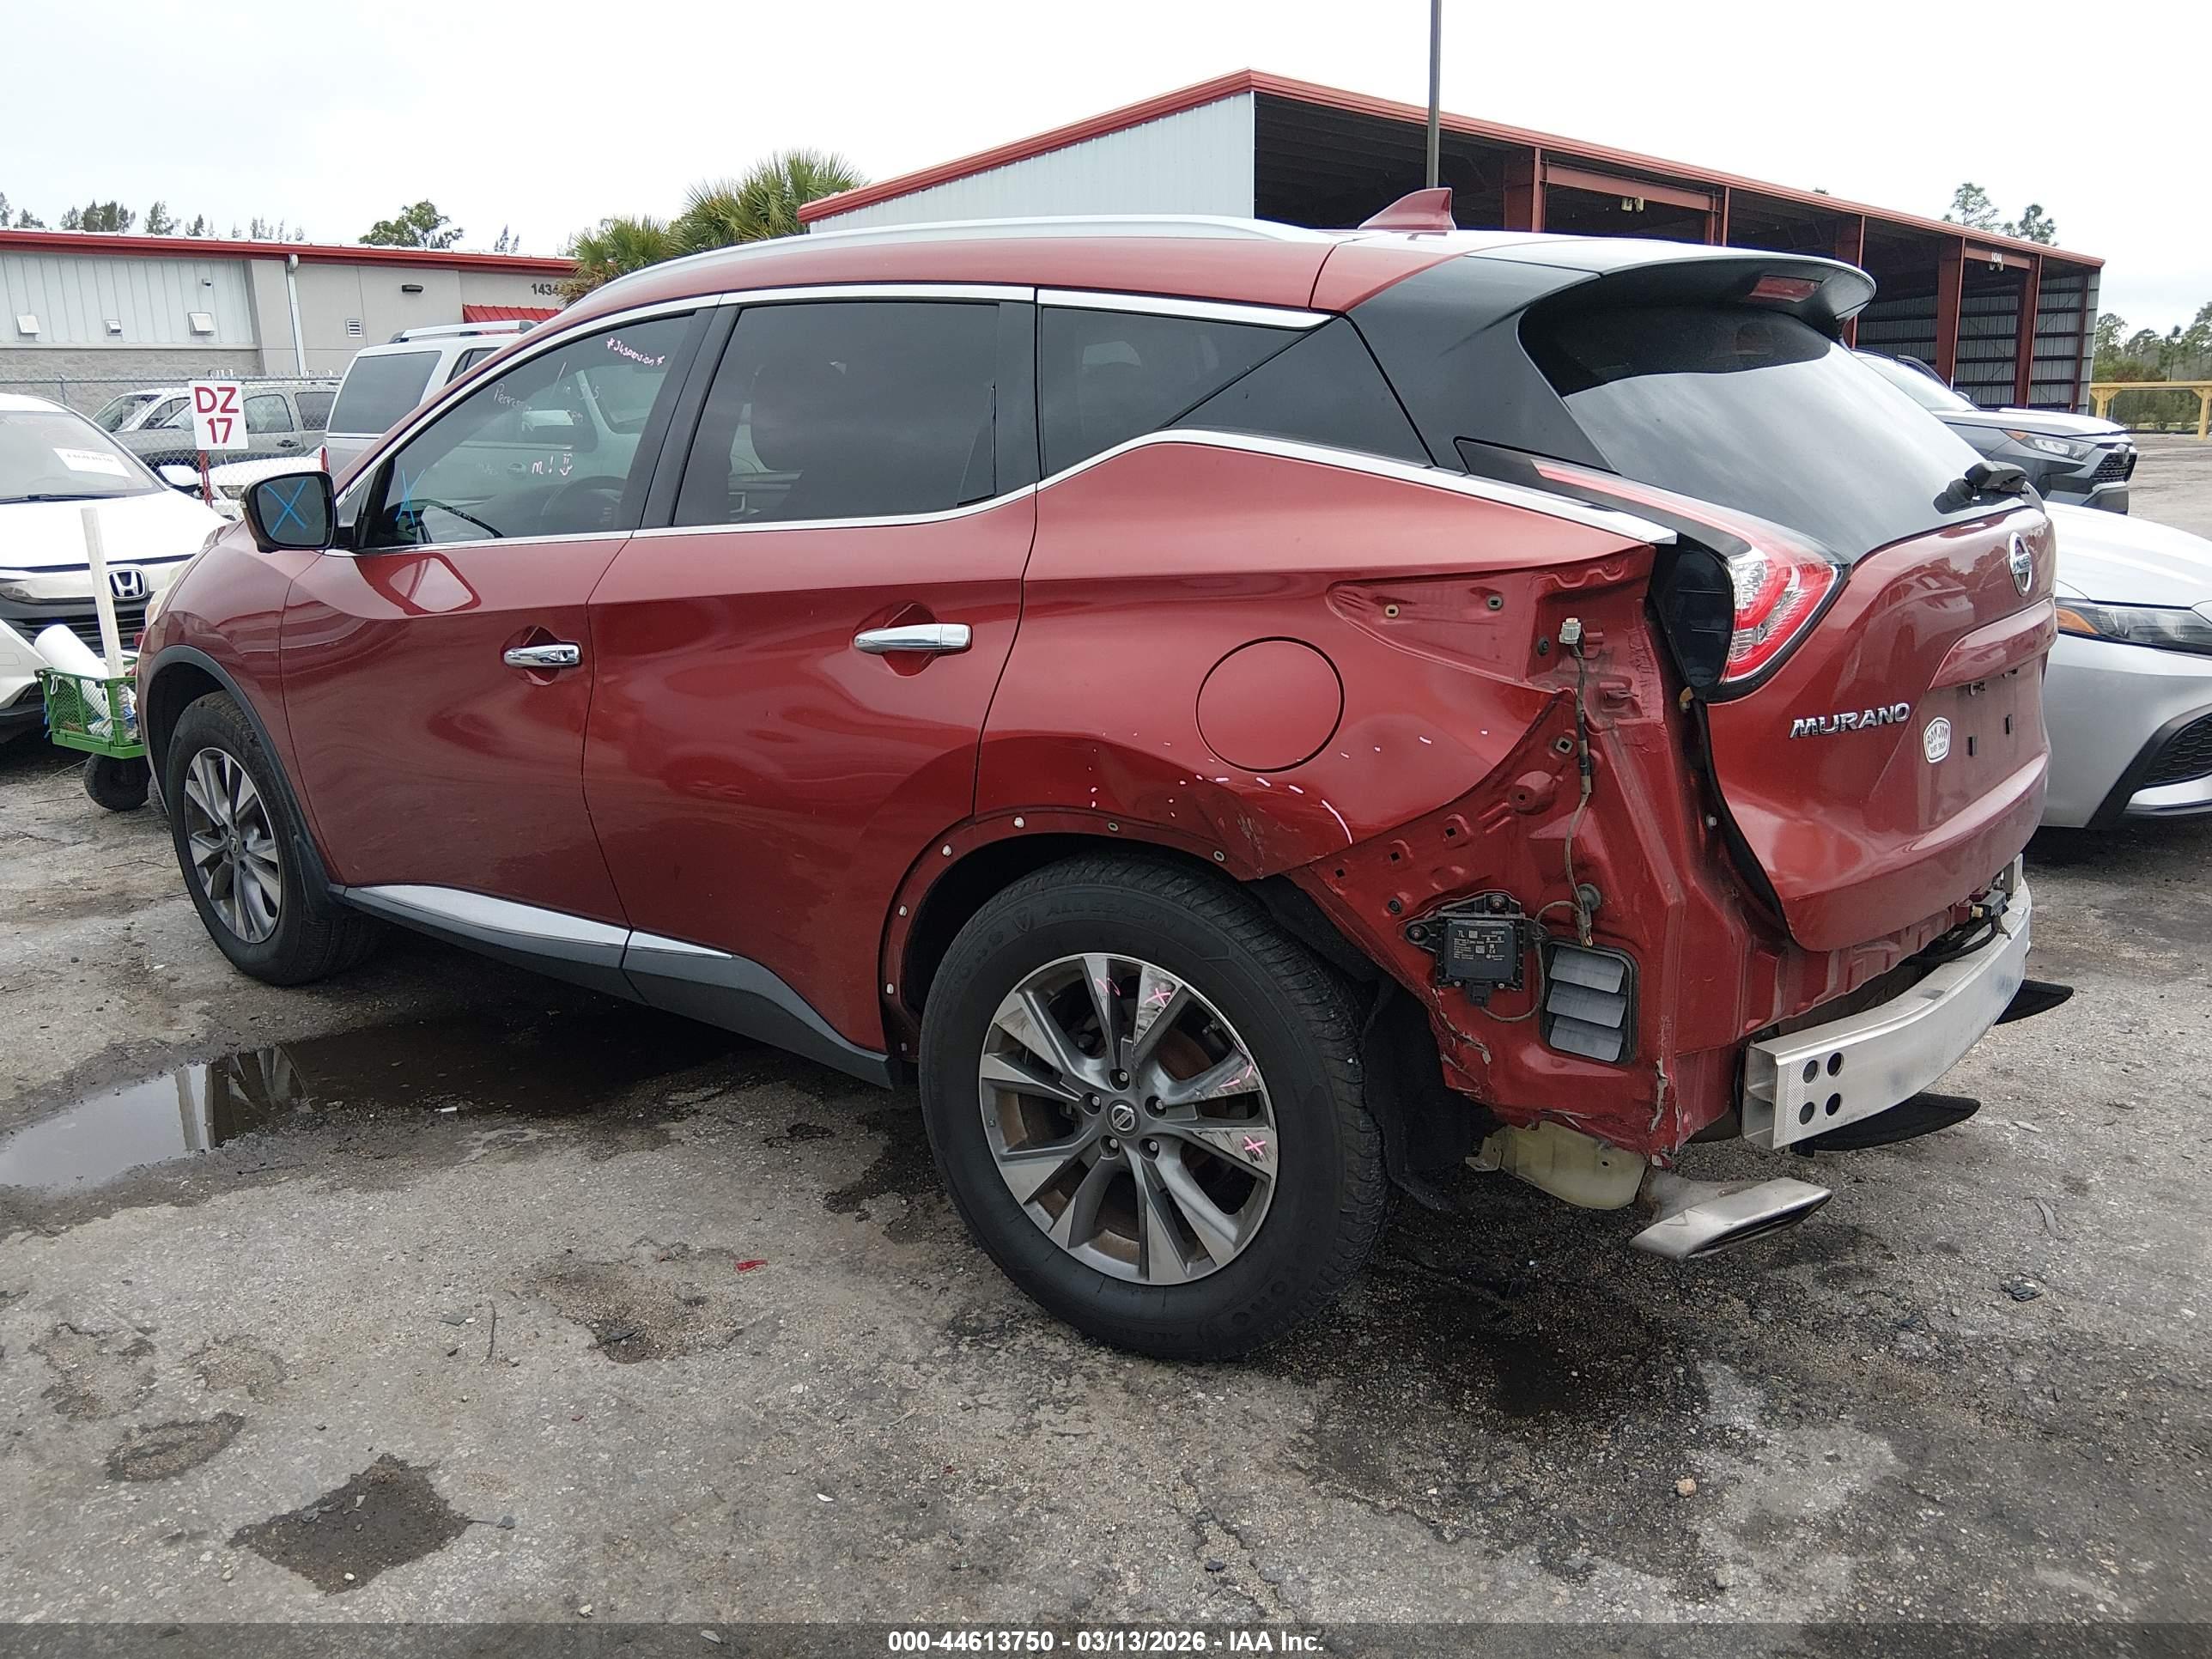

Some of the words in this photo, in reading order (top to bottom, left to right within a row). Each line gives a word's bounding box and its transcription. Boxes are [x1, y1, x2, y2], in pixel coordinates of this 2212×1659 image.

[194, 386, 240, 413] DZ
[206, 417, 233, 444] 17
[1789, 702, 1911, 739] MURANO
